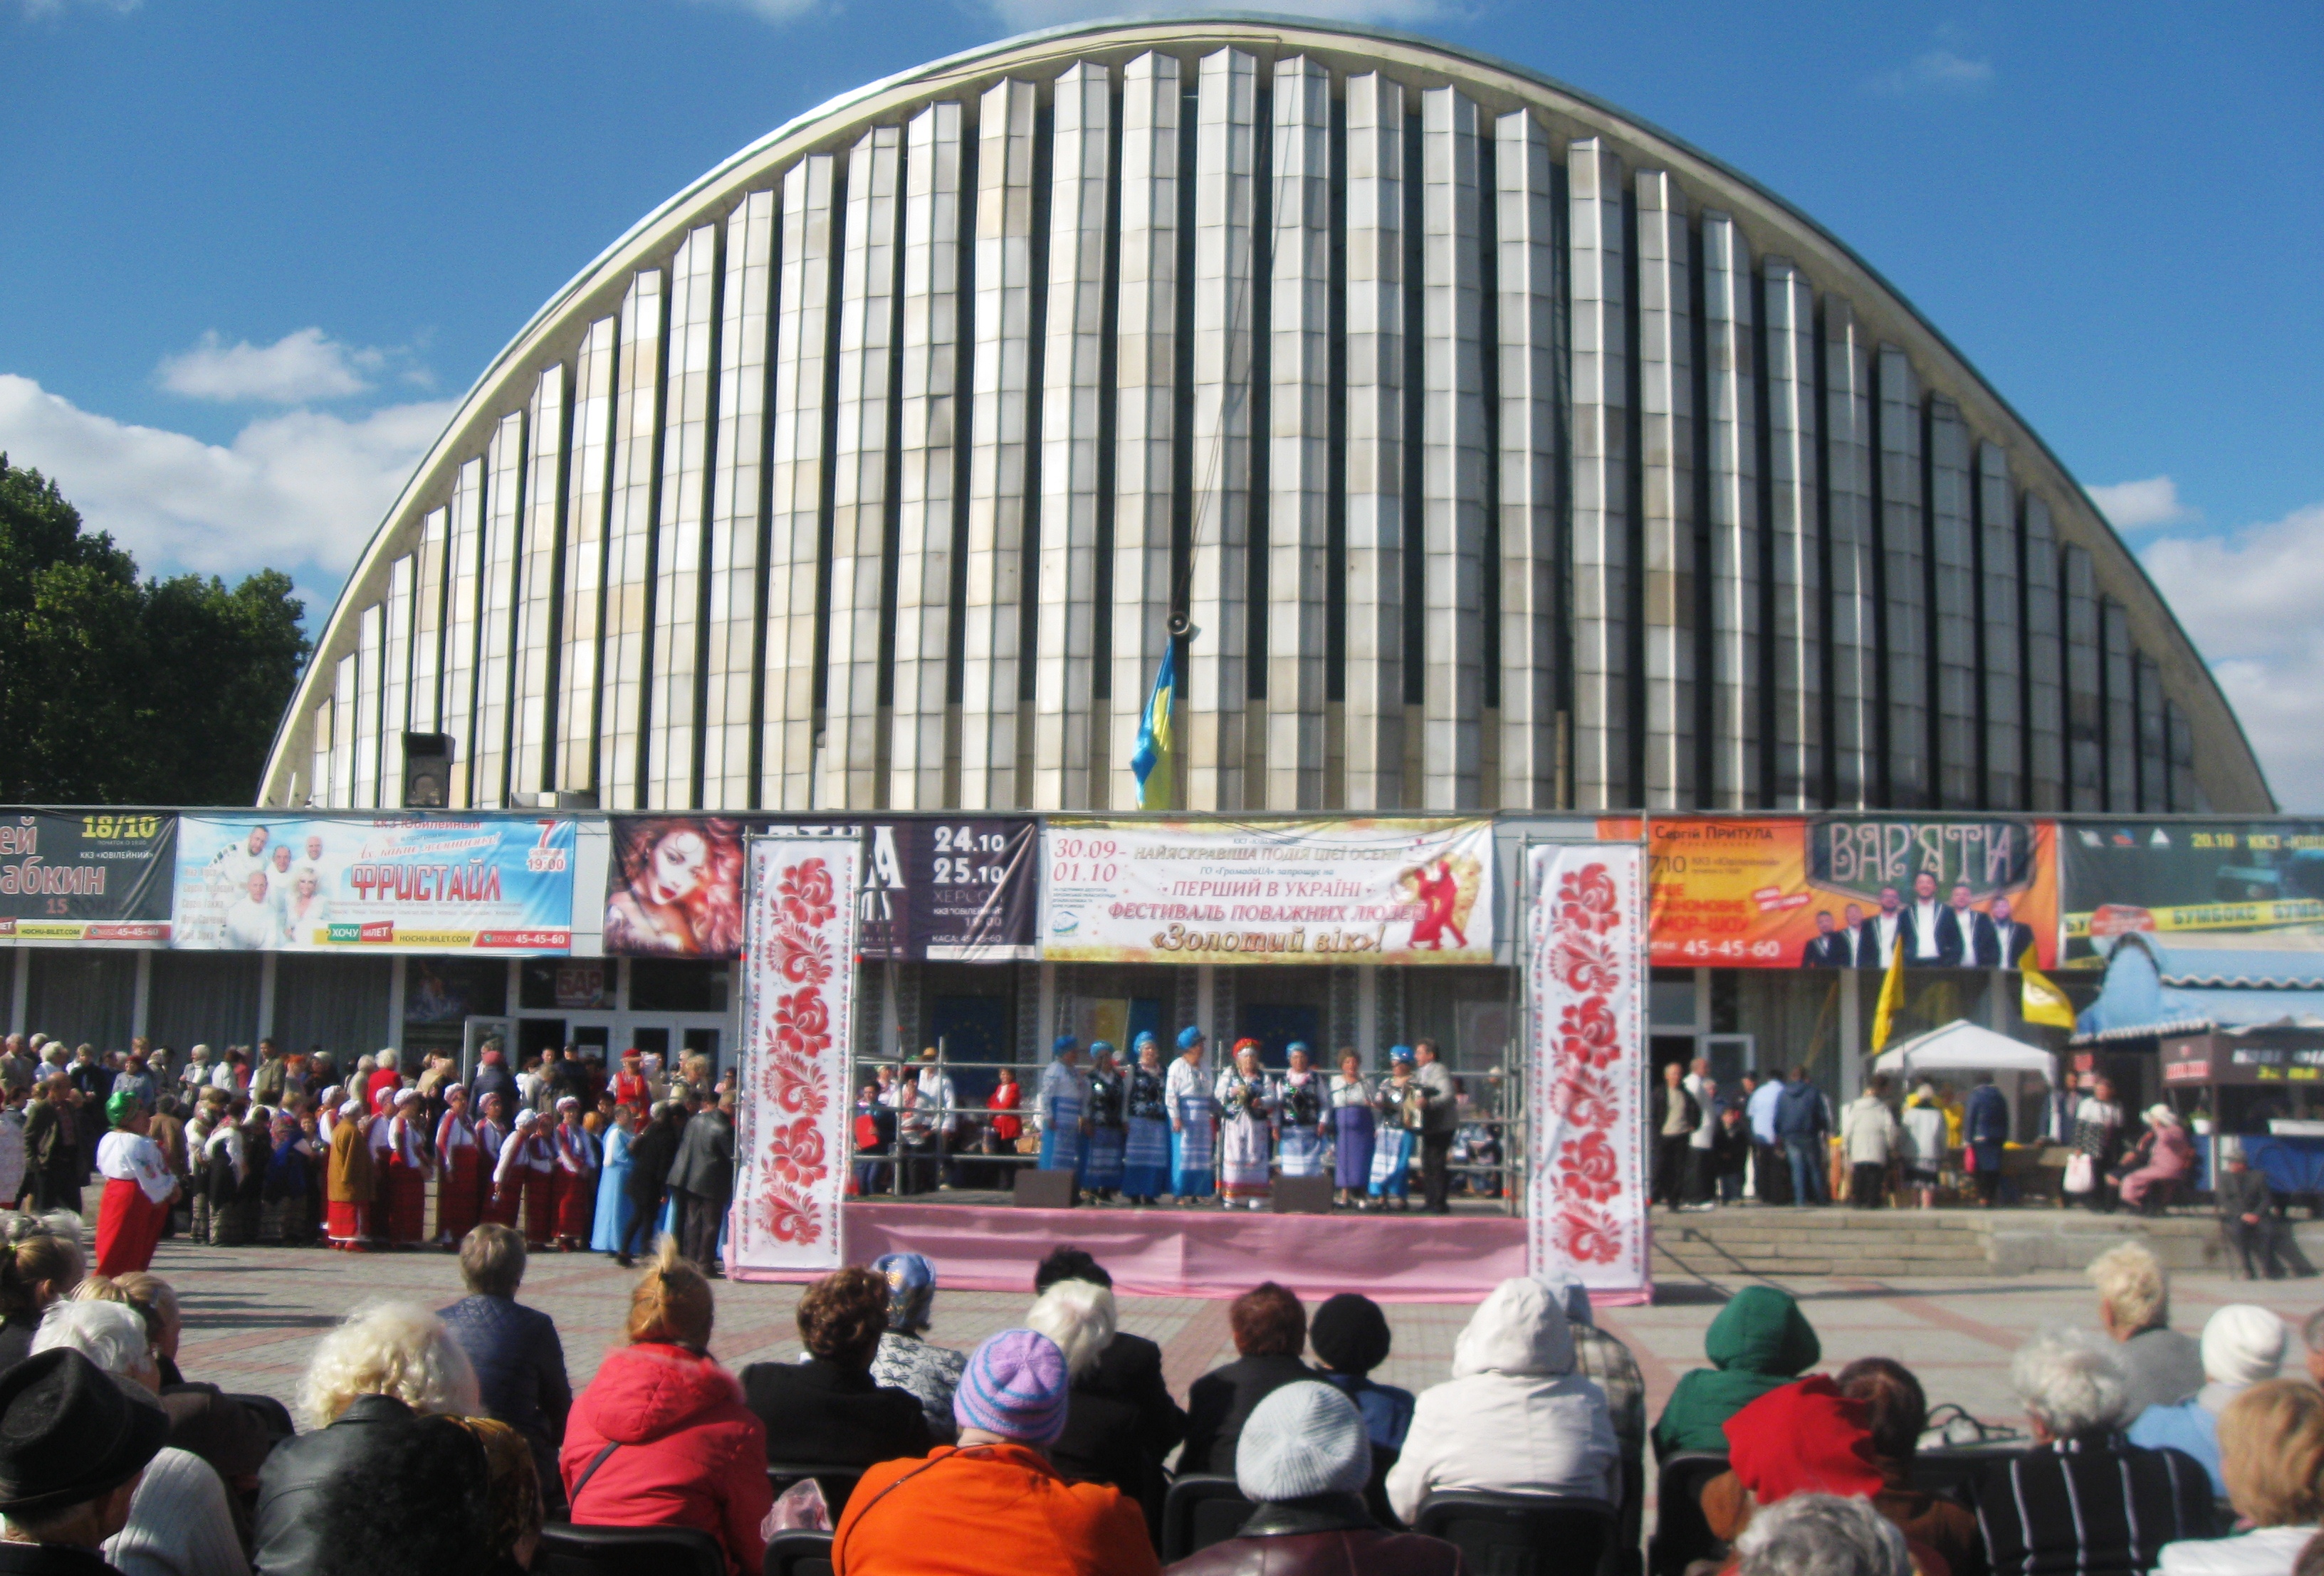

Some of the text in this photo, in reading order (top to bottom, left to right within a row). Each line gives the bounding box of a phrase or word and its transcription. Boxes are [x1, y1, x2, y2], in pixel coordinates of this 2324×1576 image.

[81, 815, 157, 839] 18/10
[536, 819, 557, 849] 7
[1655, 826, 1774, 840] Сергій ПРИТУЛА
[933, 826, 1005, 852] 24.10
[96, 849, 154, 859] «ЮВІЛЕЙНИЙ»
[527, 858, 565, 871] 19:00
[933, 857, 1005, 883] 25.10
[1053, 862, 1117, 882] 01.10
[1200, 866, 1213, 875] ГО
[351, 858, 501, 901] ФРИСТАЙЛ
[1171, 878, 1361, 897] ПЕРШИЙ В УКРАЇНІ
[46, 898, 69, 915] 15
[1108, 902, 1224, 920] ФЕСТИВАЛЬ
[1230, 904, 1346, 921] ПОВАЖНИХ
[332, 928, 359, 937] ХОЧУ
[399, 935, 471, 943] HOCHU-BILET.COM
[515, 934, 565, 945] 45-45-60
[1149, 923, 1385, 953] «Золотий вік»!
[1683, 940, 1780, 957] 45-45-60
